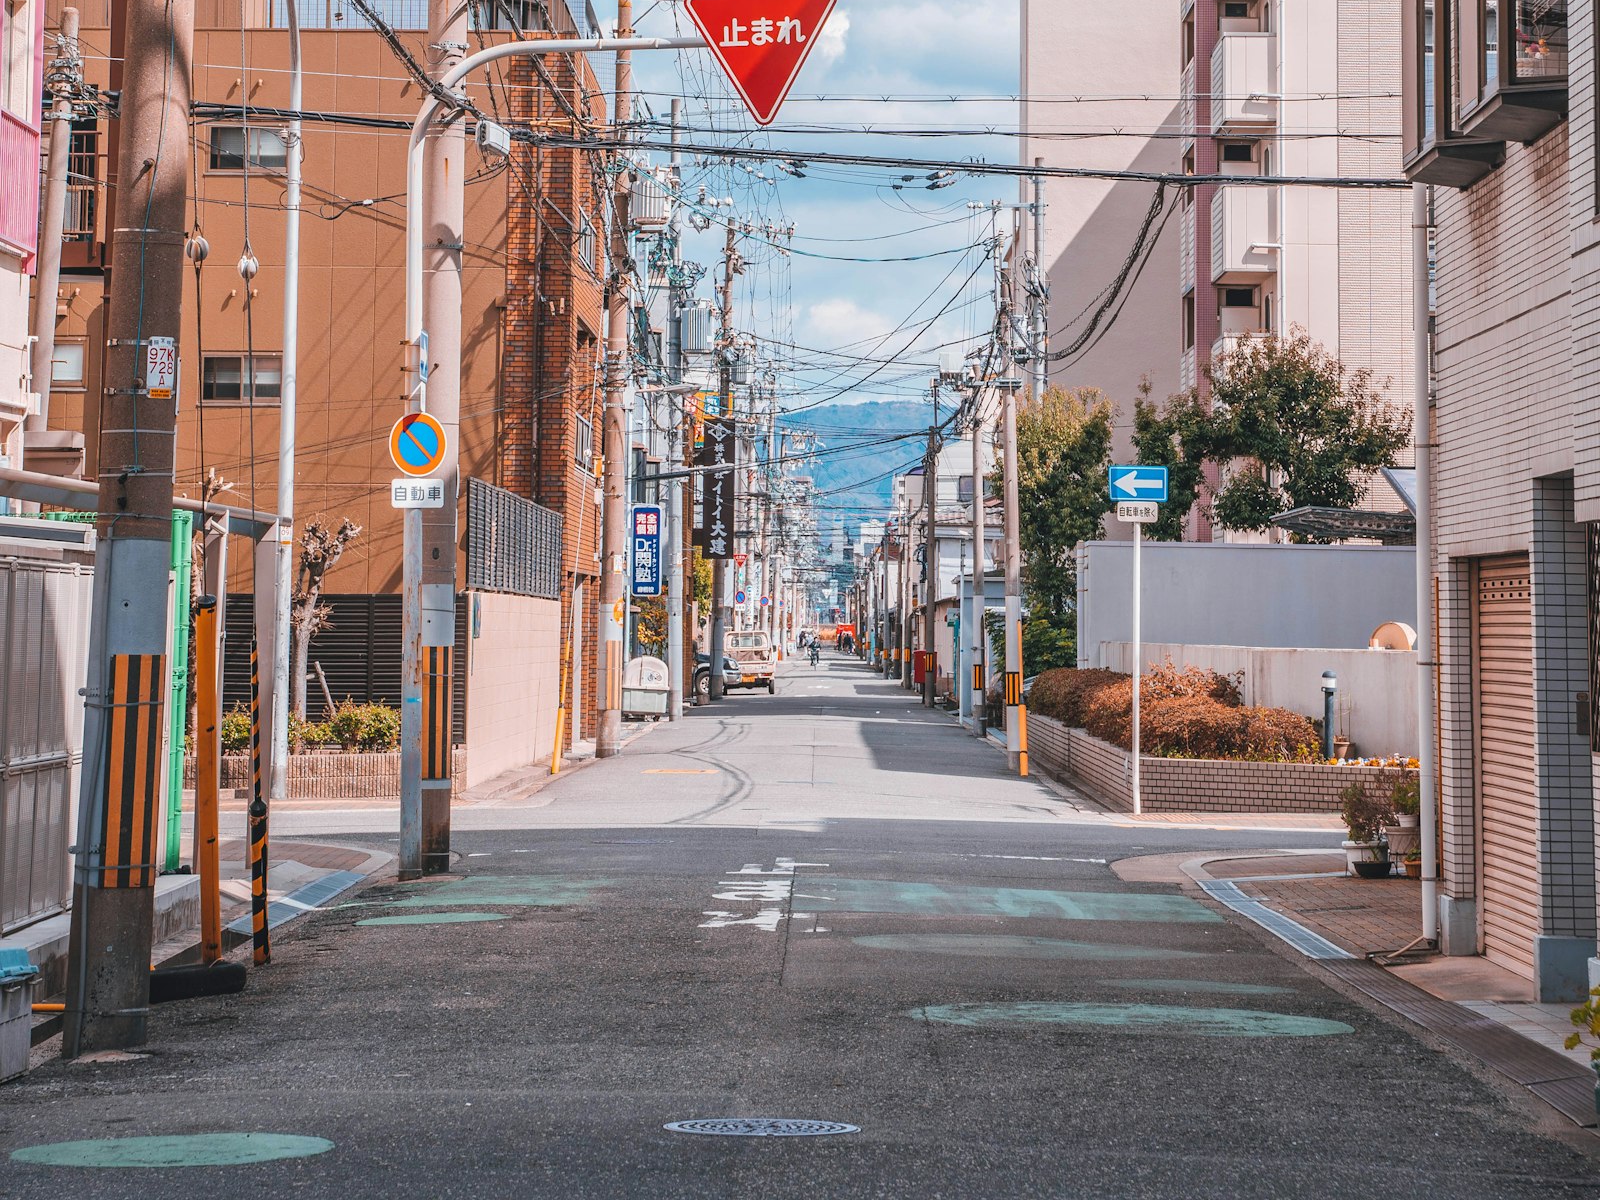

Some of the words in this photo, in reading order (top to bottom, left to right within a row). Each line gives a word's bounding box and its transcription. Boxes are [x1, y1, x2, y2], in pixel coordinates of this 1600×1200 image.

[719, 16, 806, 47] 止まれ
[149, 347, 174, 361] 97K
[149, 361, 174, 375] 728
[394, 486, 442, 501] 自動車
[709, 443, 728, 556] 株式社イトイ大建
[636, 513, 658, 524] 完全
[1119, 506, 1156, 518] 自転車を除く
[636, 524, 658, 535] 個別
